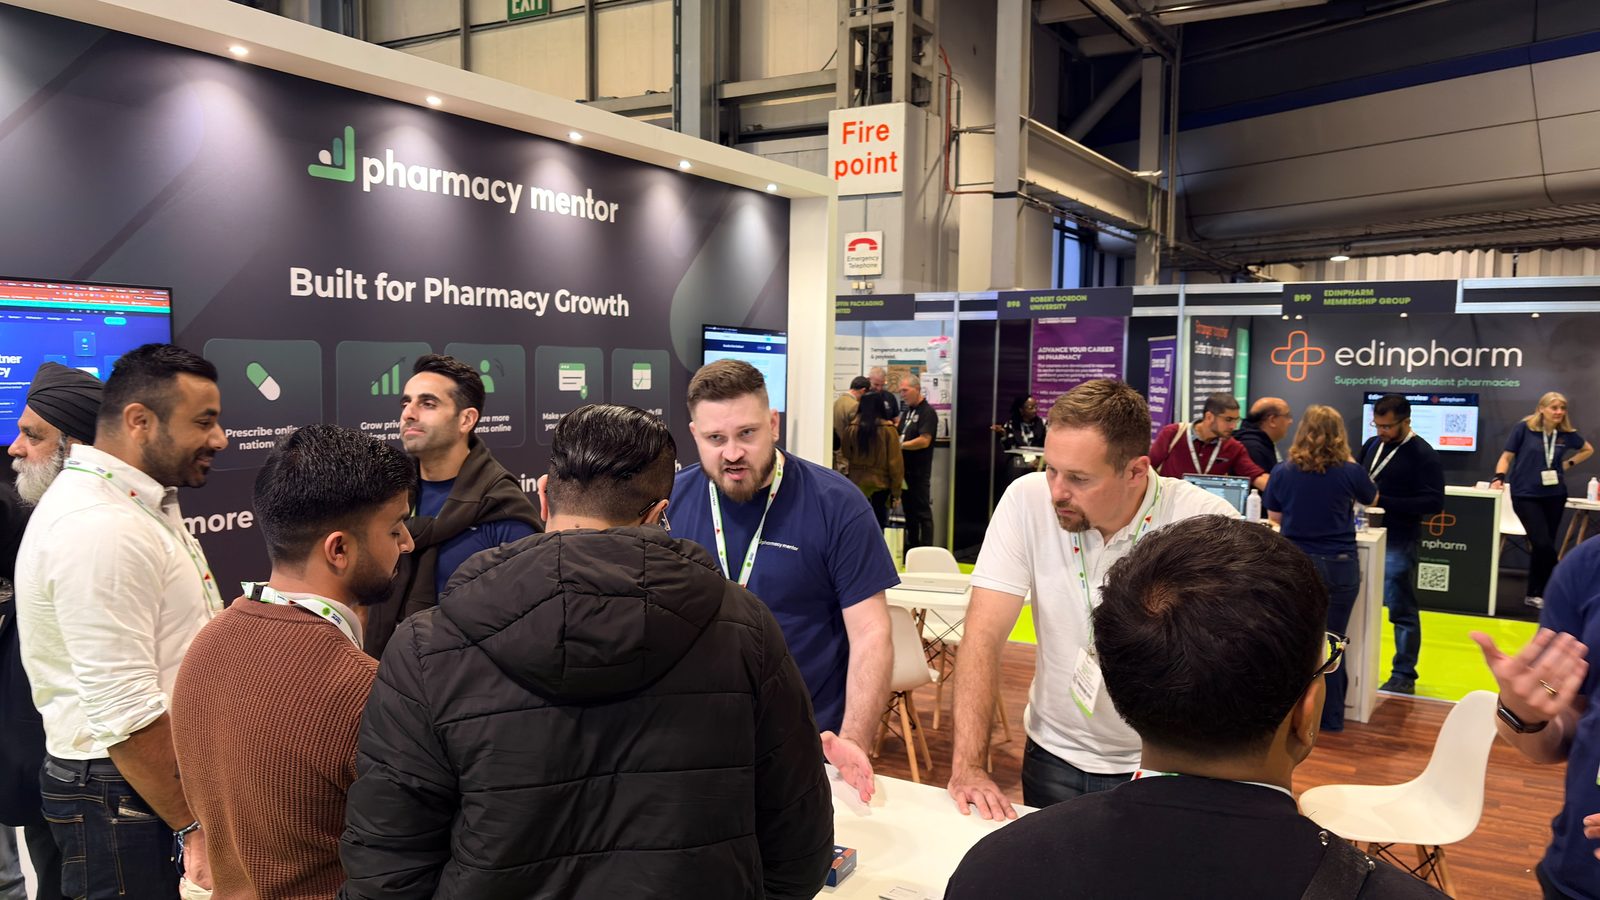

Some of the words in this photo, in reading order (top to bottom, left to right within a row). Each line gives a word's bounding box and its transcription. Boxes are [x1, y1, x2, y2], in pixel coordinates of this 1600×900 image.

[842, 121, 889, 145] Fire
[834, 151, 898, 180] point
[362, 148, 523, 214] pharmacy
[530, 186, 619, 223] mentor
[847, 255, 879, 263] Emergency
[290, 267, 367, 300] Built
[375, 272, 416, 302] for
[424, 277, 549, 317] Pharmacy
[555, 288, 629, 318] Growth
[1323, 289, 1374, 297] EDINPHARM
[1030, 295, 1056, 303] ROBERT
[1056, 294, 1088, 302] GORDON
[1293, 293, 1311, 302] B99
[1323, 298, 1377, 306] MEMBERSHIP
[1379, 297, 1411, 305] GROUP
[1030, 303, 1067, 311] UNIVERSITY
[1334, 339, 1522, 373] edinpharm
[1334, 375, 1388, 386] Supporting
[1390, 376, 1455, 387] independent
[1457, 377, 1520, 388] pharmacies
[542, 412, 559, 420] Make
[360, 421, 383, 430] Grow
[490, 424, 512, 432] online
[225, 426, 273, 438] Prescribe
[183, 510, 254, 535] more
